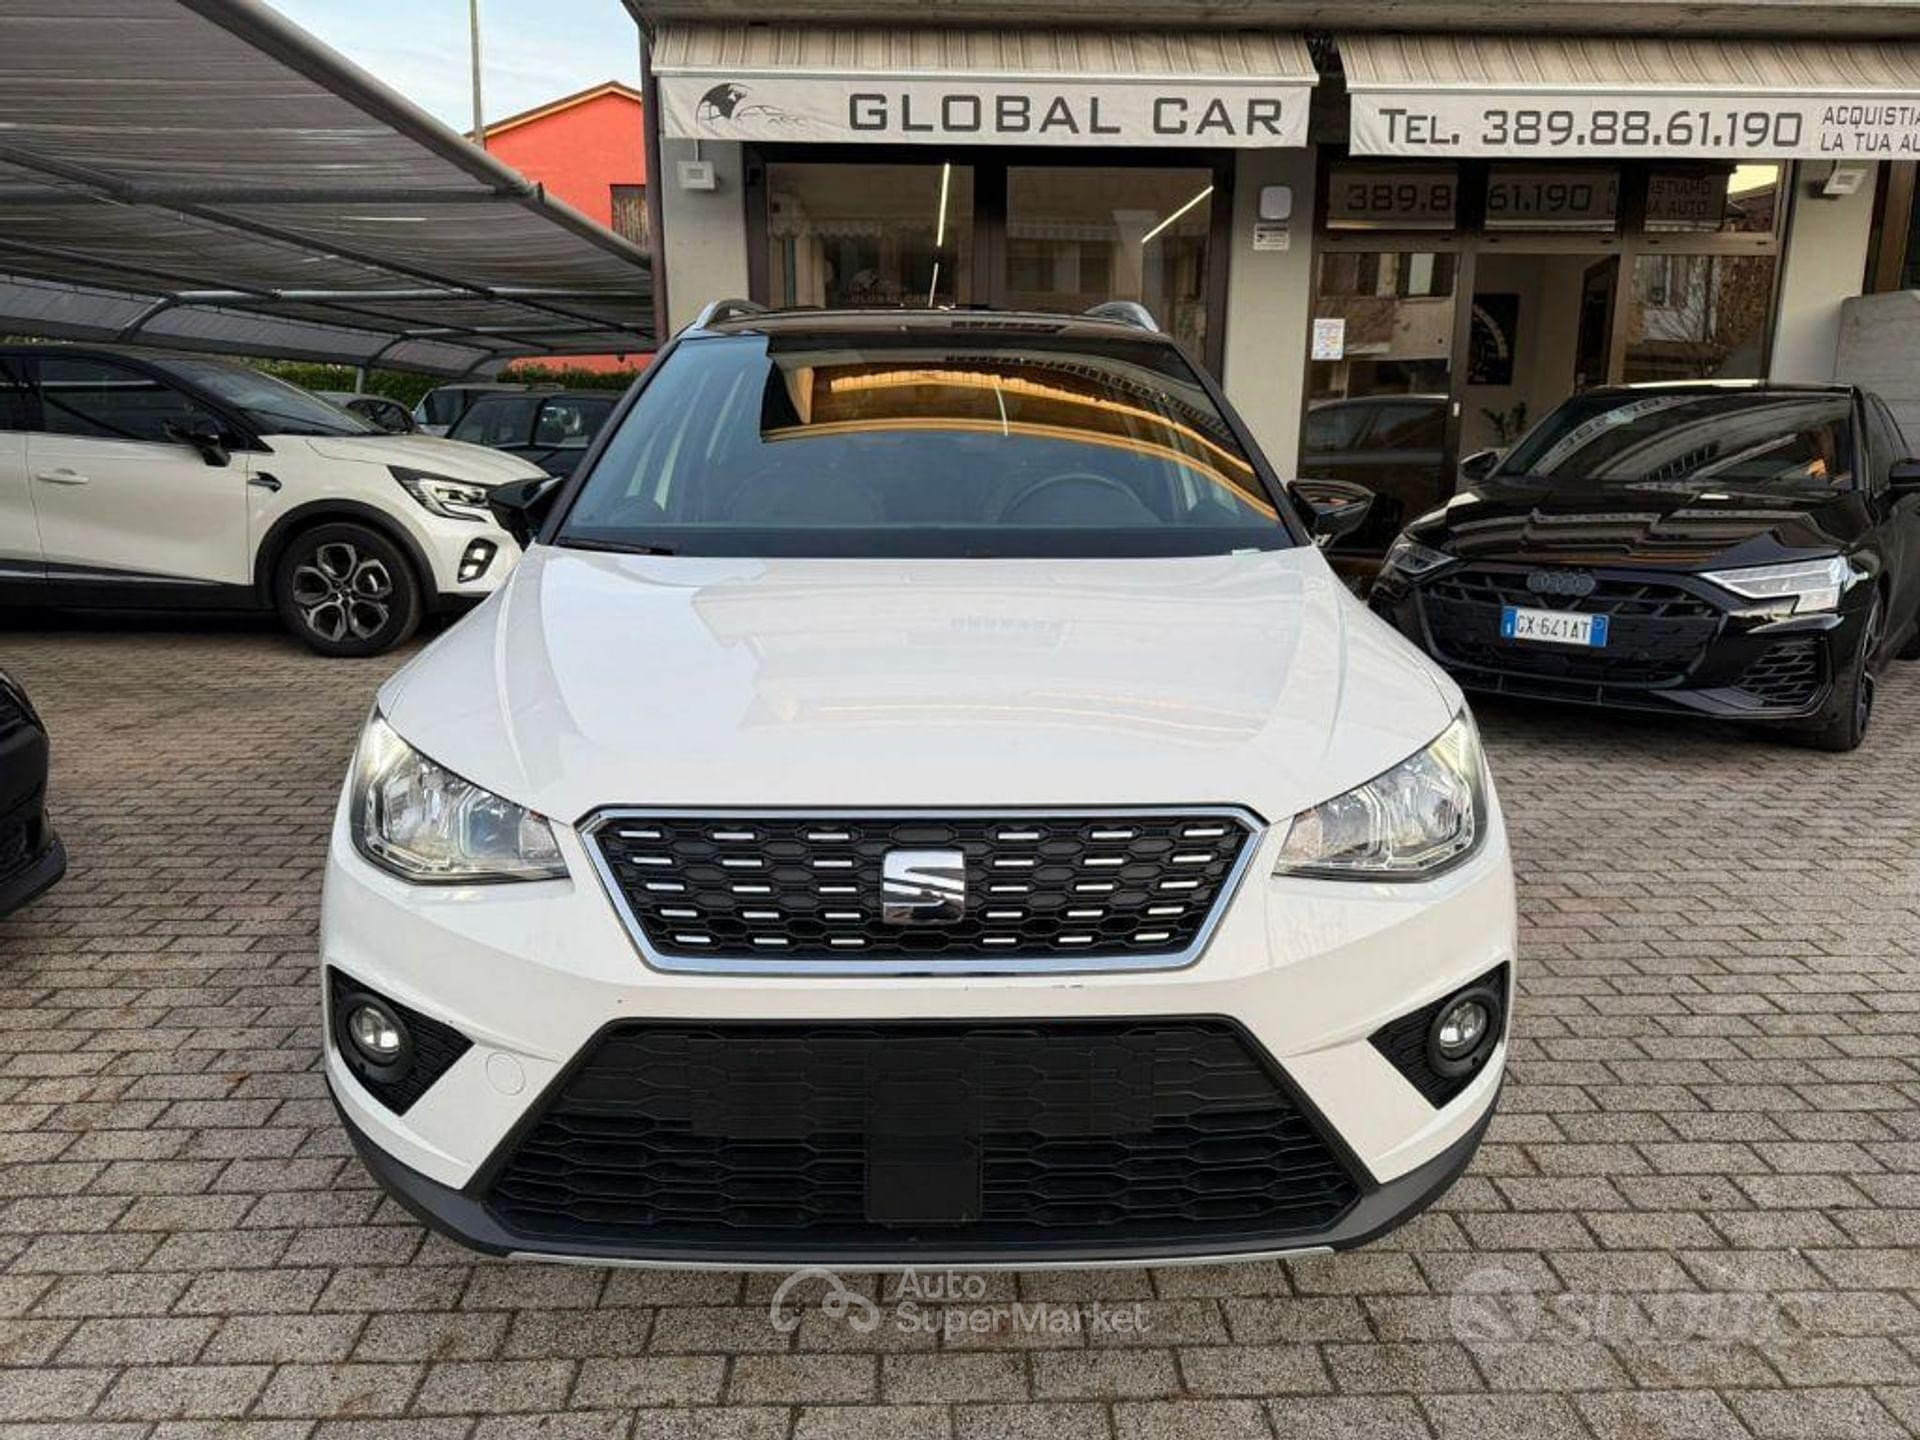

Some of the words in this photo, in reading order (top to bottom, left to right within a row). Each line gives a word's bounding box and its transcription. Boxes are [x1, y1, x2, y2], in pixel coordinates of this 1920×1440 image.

[849, 93, 1122, 135] GLOBAL
[1152, 97, 1284, 136] CAR
[1481, 110, 1804, 147] 389.88.61.190
[1820, 132, 1844, 151] LA
[1854, 132, 1892, 151] TUA
